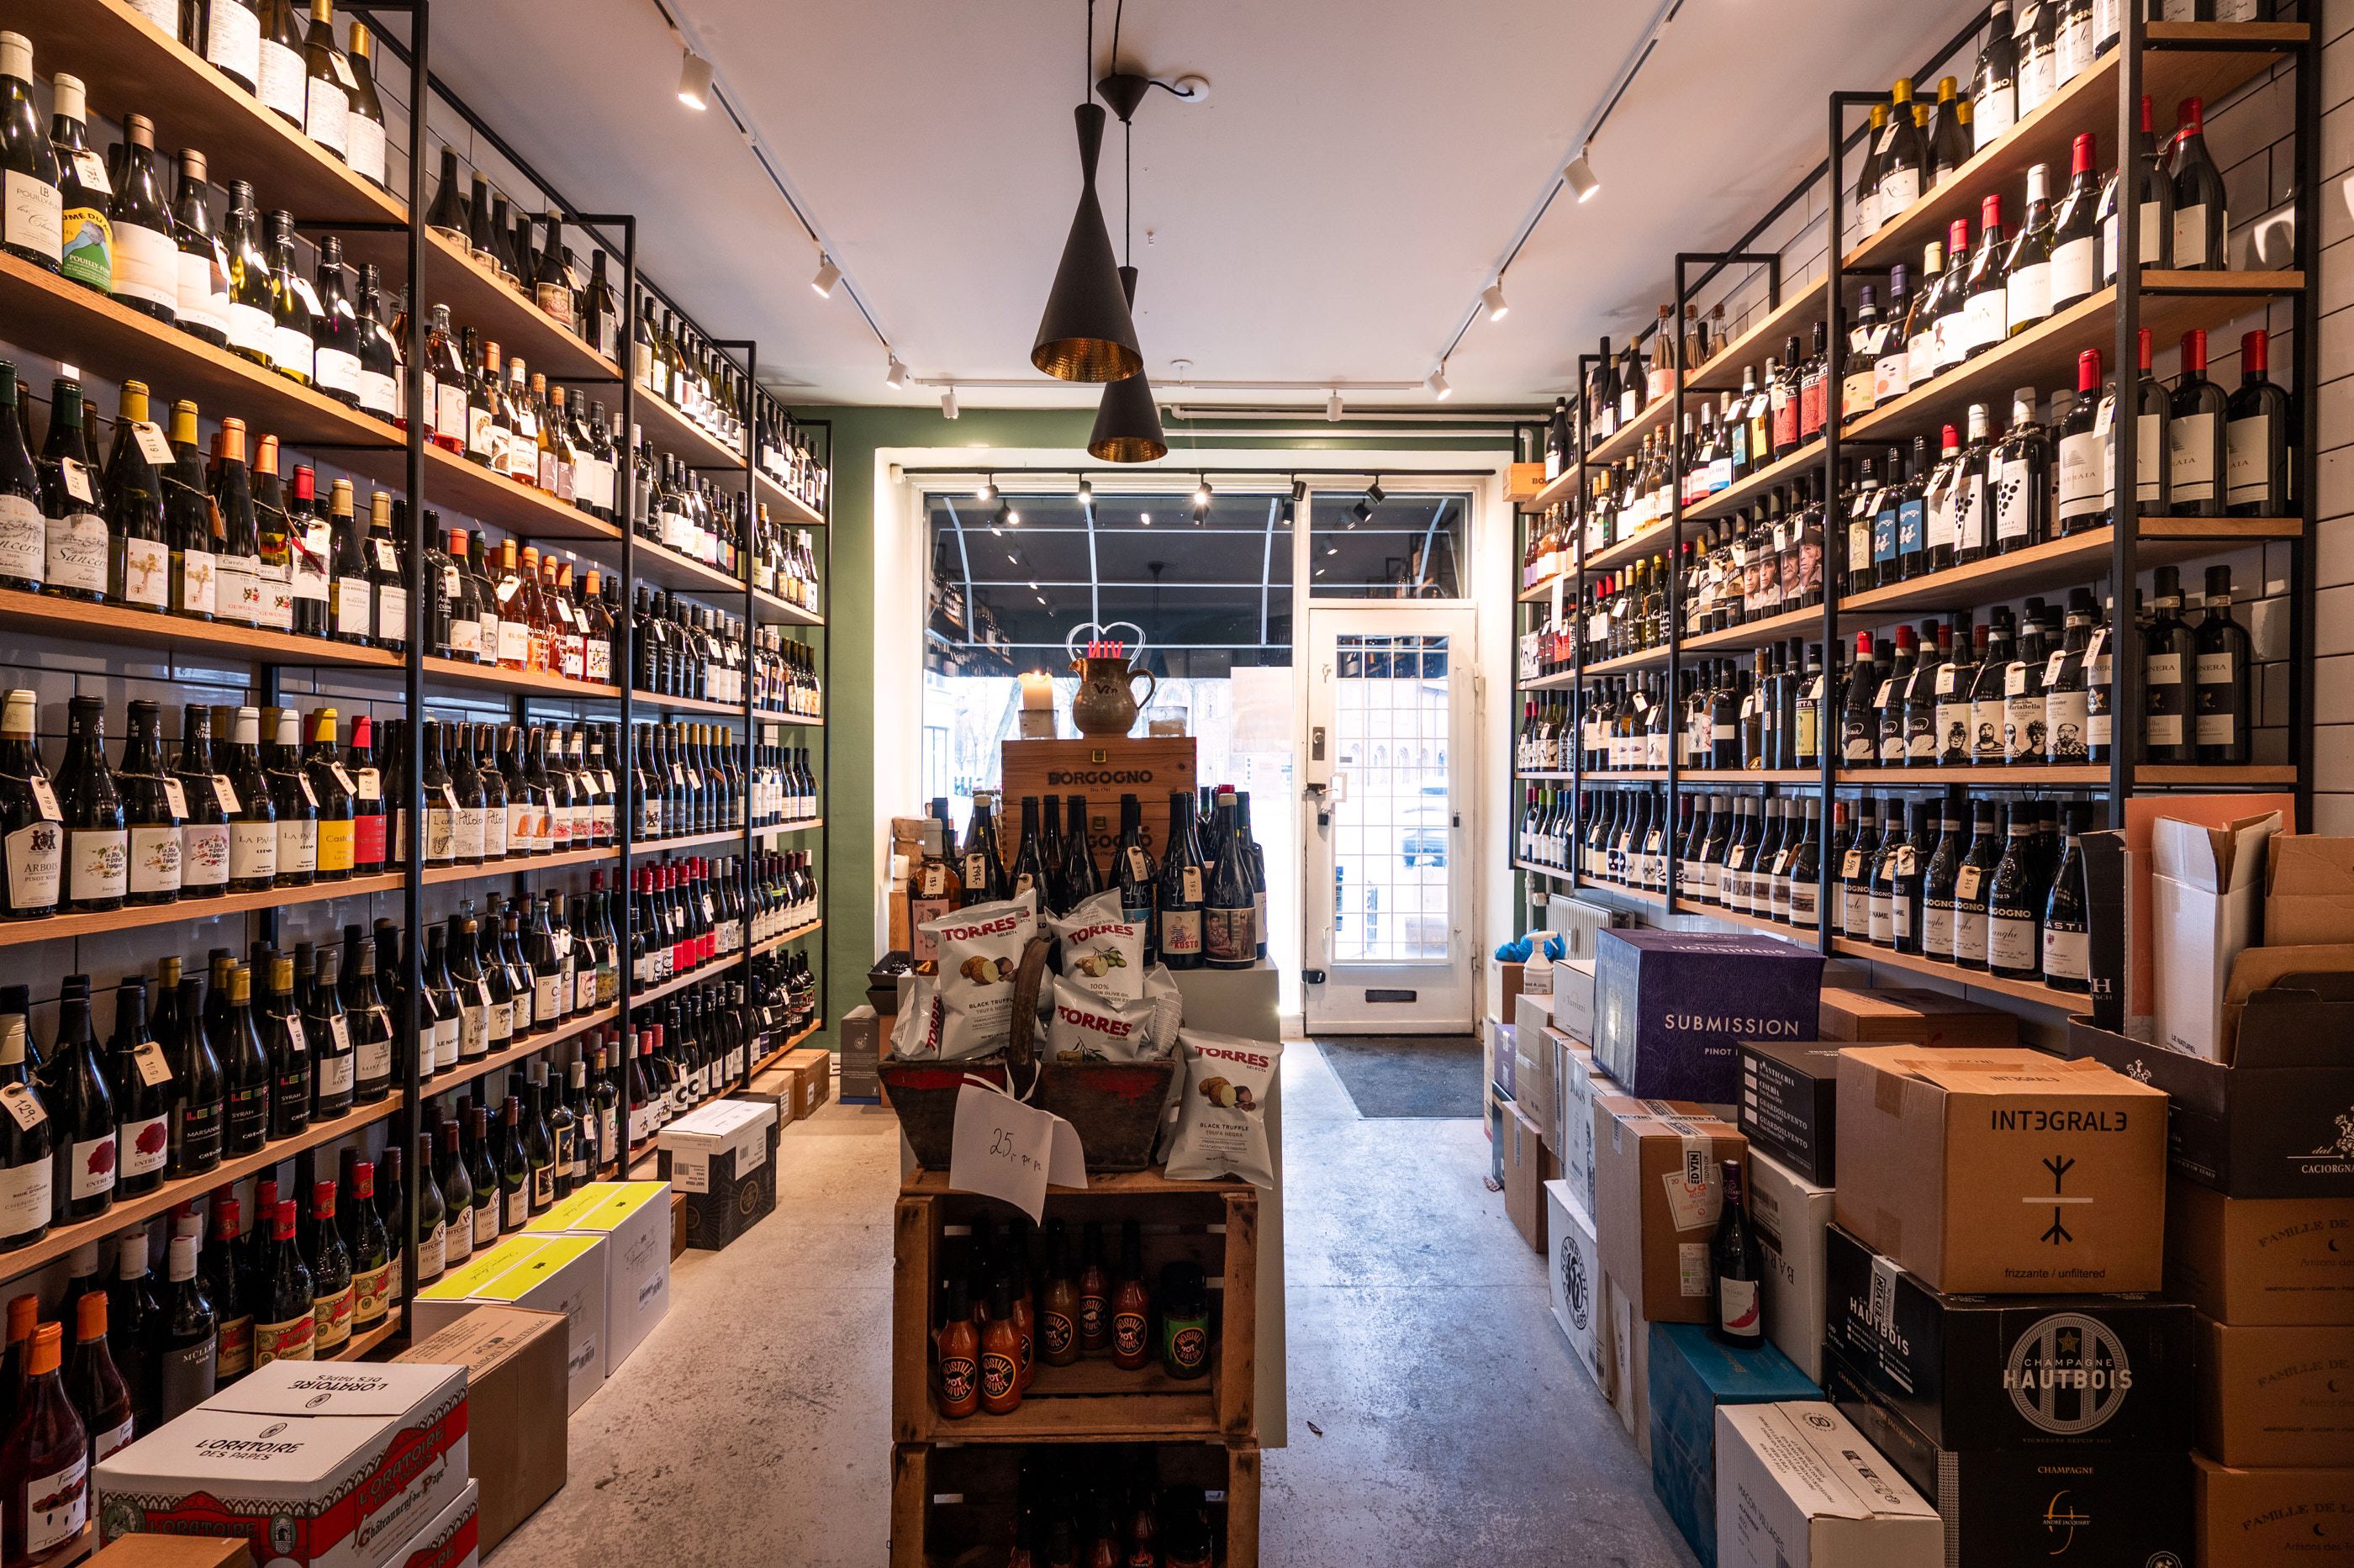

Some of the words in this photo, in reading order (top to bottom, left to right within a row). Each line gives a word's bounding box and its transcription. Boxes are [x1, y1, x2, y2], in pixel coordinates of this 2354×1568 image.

[1048, 769, 1153, 785] BORGOGNO
[24, 862, 58, 874] ARBOIS
[941, 916, 1016, 942] TORRES
[1068, 924, 1134, 947] TORRES
[990, 998, 1014, 1007] TRUFFL
[926, 995, 942, 1052] TORRES
[1058, 1005, 1133, 1037] TORRES
[1664, 1013, 1799, 1037] SUBMISSION
[1195, 1045, 1269, 1069] TORRES
[1704, 1048, 1732, 1056] PINOT
[282, 1092, 302, 1101] SYRAH
[231, 1109, 254, 1118] SYRAH
[135, 1156, 156, 1168] ENTRE
[2259, 1220, 2324, 1248] FAMILLE
[2330, 1219, 2349, 1229] DE
[2004, 1267, 2050, 1279] frizzante
[2057, 1267, 2106, 1279] unfiltered
[2024, 1358, 2113, 1368] CHAMPAGNE
[2003, 1368, 2134, 1390] HAUTBOIS
[2257, 1360, 2323, 1387] FAMILLE
[2328, 1359, 2349, 1370] DE
[287, 1381, 389, 1391] L'ORATOIRE
[194, 1439, 304, 1454] L'ORATOIRE
[198, 1450, 225, 1460] DES
[229, 1451, 273, 1460] PAPES
[359, 1425, 444, 1507] L'ORATOIRE
[2037, 1465, 2095, 1476] CHAMPAGNE
[2242, 1504, 2309, 1532] FAMILLE
[2314, 1502, 2336, 1513] DE
